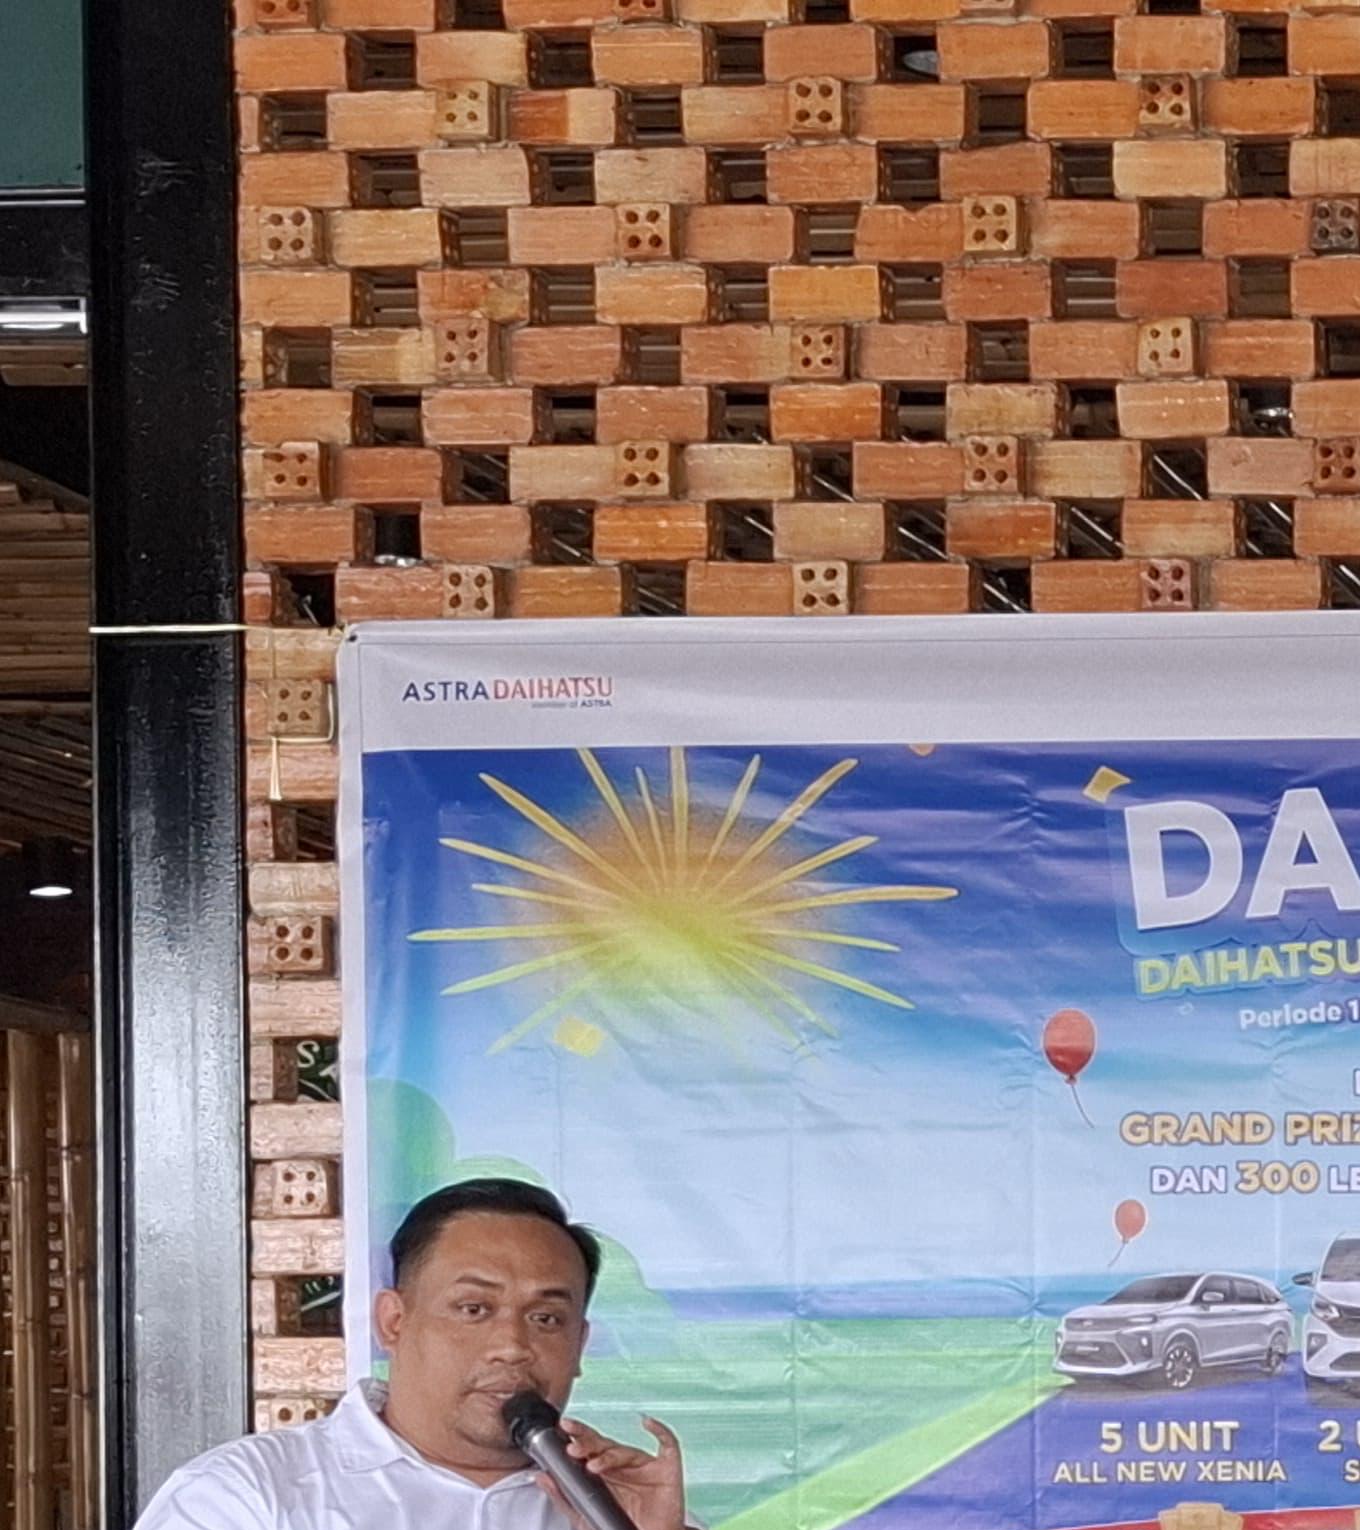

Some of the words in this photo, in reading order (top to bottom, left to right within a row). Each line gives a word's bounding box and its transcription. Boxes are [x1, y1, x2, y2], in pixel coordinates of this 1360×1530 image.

[580, 700, 612, 708] ASTRA
[1239, 1002, 1342, 1029] Periode
[1347, 1000, 1360, 1021] 1
[1120, 1111, 1275, 1145] GRAND
[1150, 1166, 1228, 1194] DAN
[1236, 1159, 1321, 1194] 300
[1100, 1421, 1123, 1453] 5
[1137, 1420, 1240, 1453] UNIT
[1317, 1419, 1343, 1452] 2
[1052, 1461, 1108, 1484] ALL
[1116, 1460, 1187, 1483] NEW
[1197, 1459, 1287, 1483] XENIA
